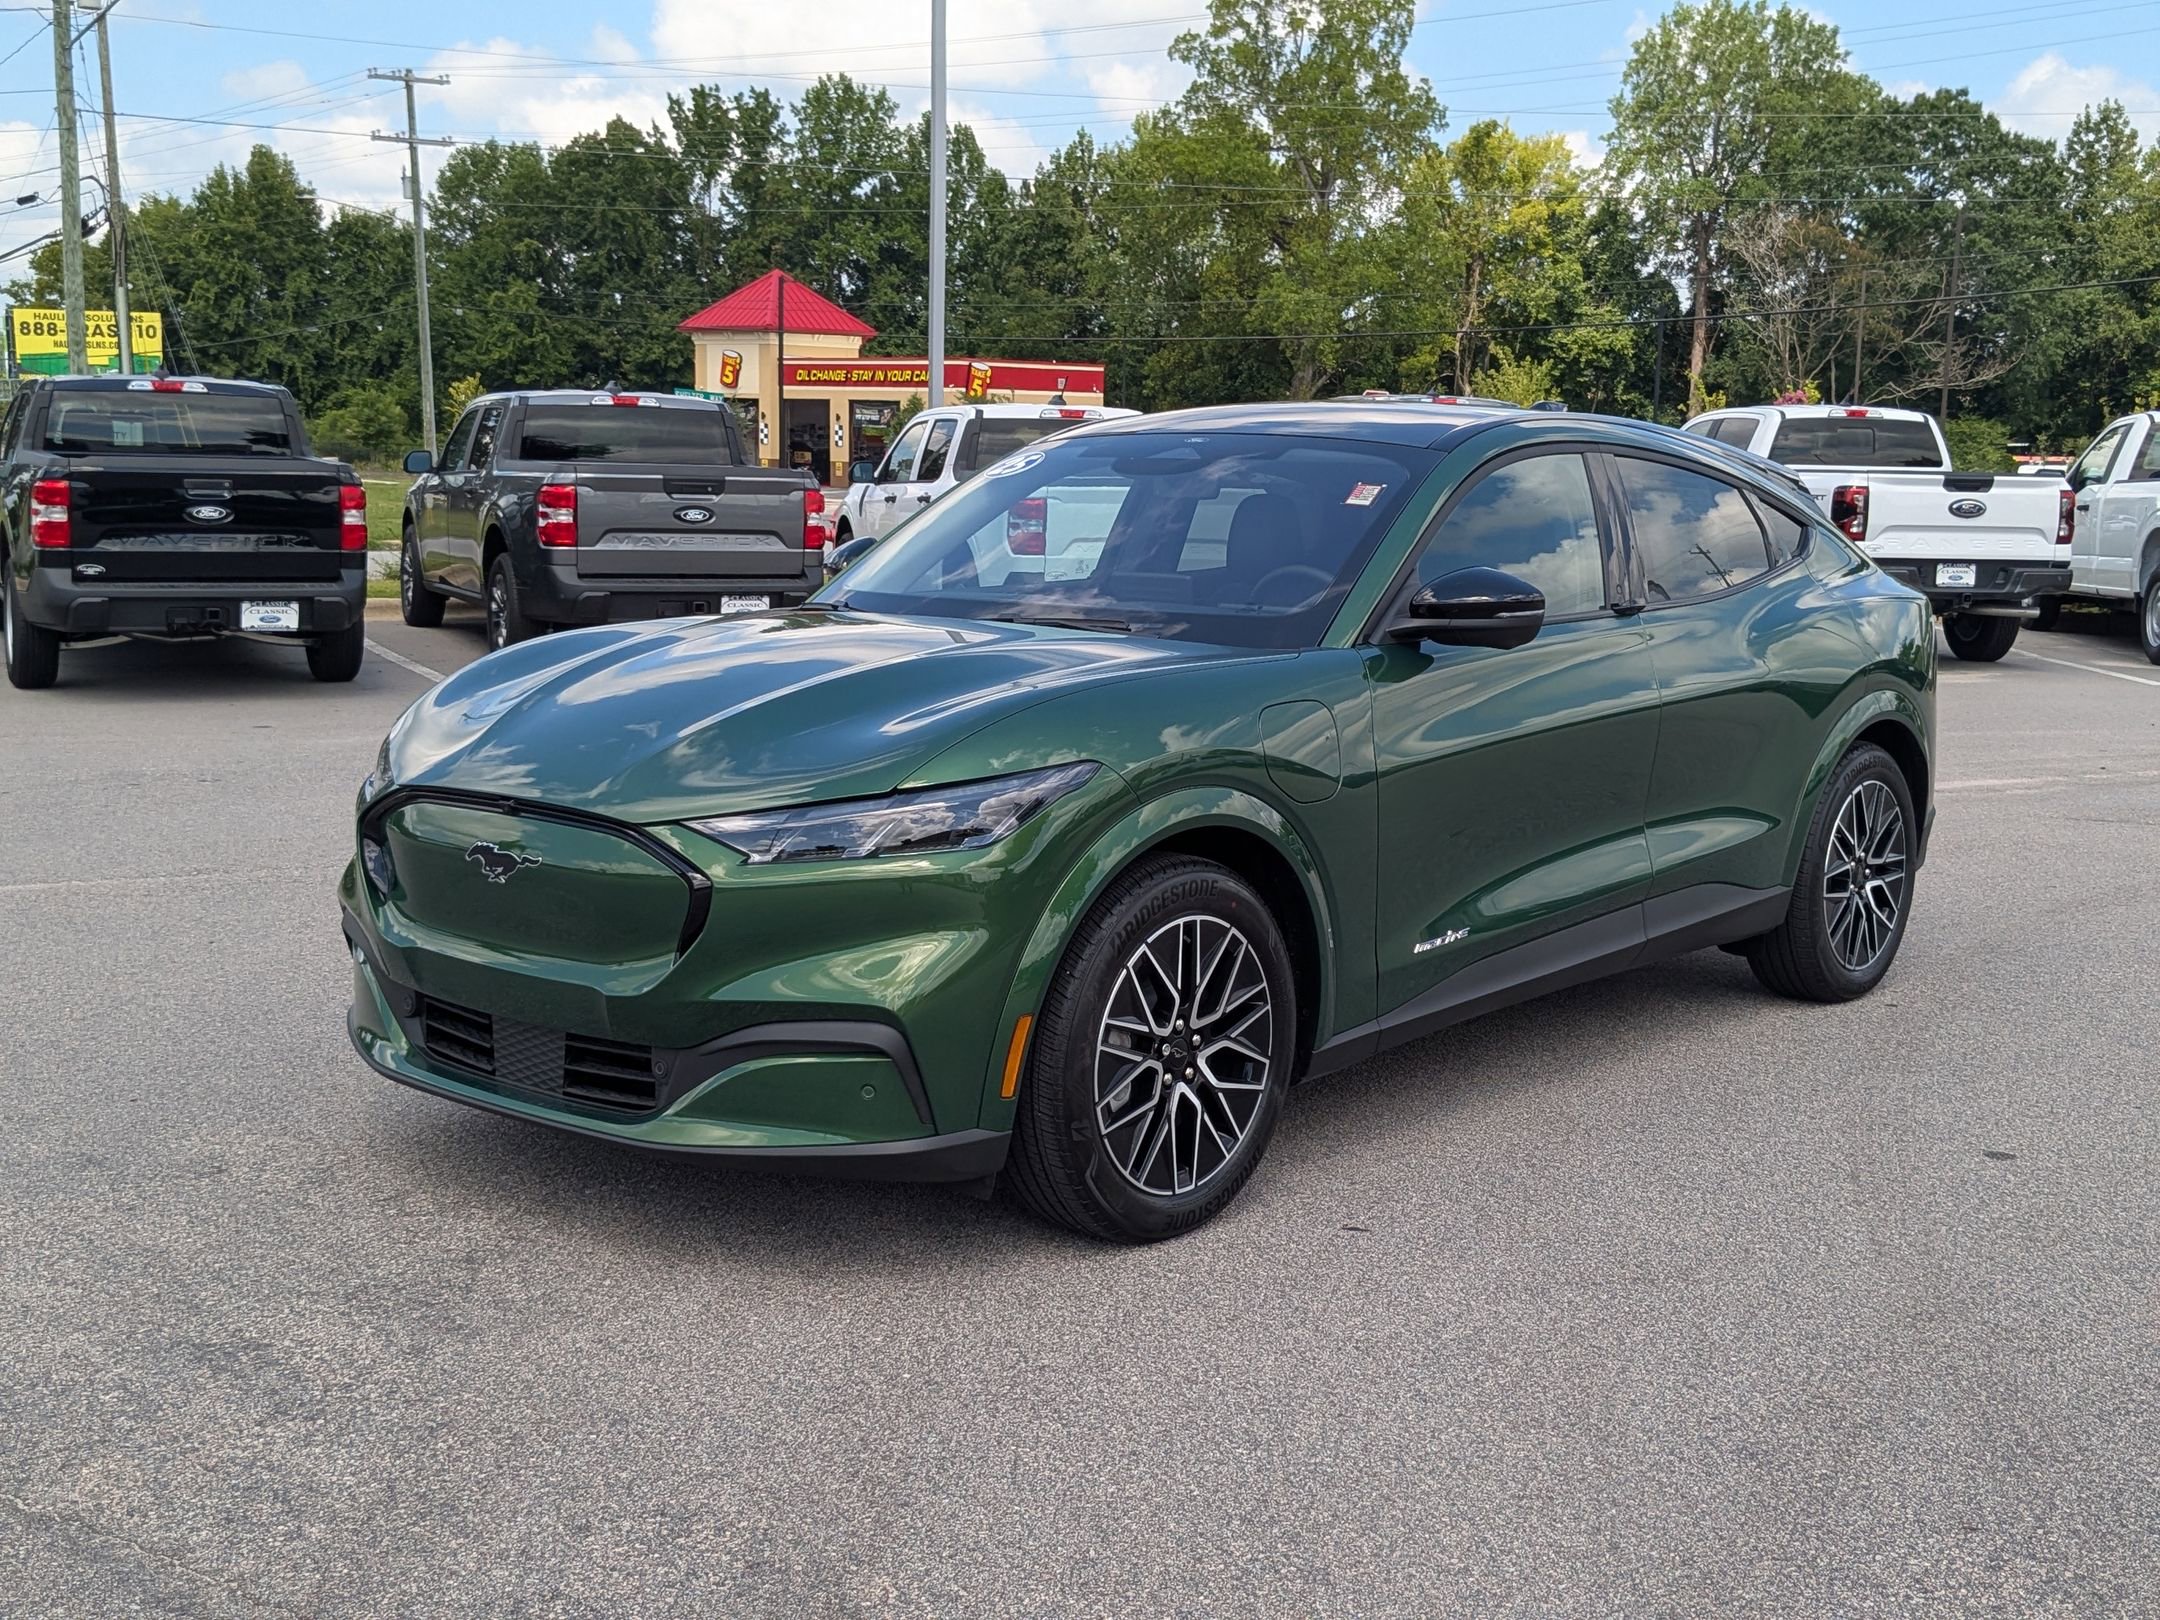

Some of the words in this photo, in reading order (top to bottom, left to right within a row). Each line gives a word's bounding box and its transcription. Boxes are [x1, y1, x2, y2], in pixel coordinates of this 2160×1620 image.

[86, 314, 144, 323] SOLUNS
[20, 321, 157, 339] 888-AS10
[722, 366, 734, 384] 5
[796, 370, 809, 381] OIL
[810, 370, 847, 381] CHANGE
[851, 370, 873, 381] STAY
[874, 370, 885, 381] IN
[887, 370, 912, 381] YOUR
[969, 378, 983, 397] 5
[611, 535, 774, 547] MAVERICK
[1110, 879, 1219, 956] BRIDGESTONE
